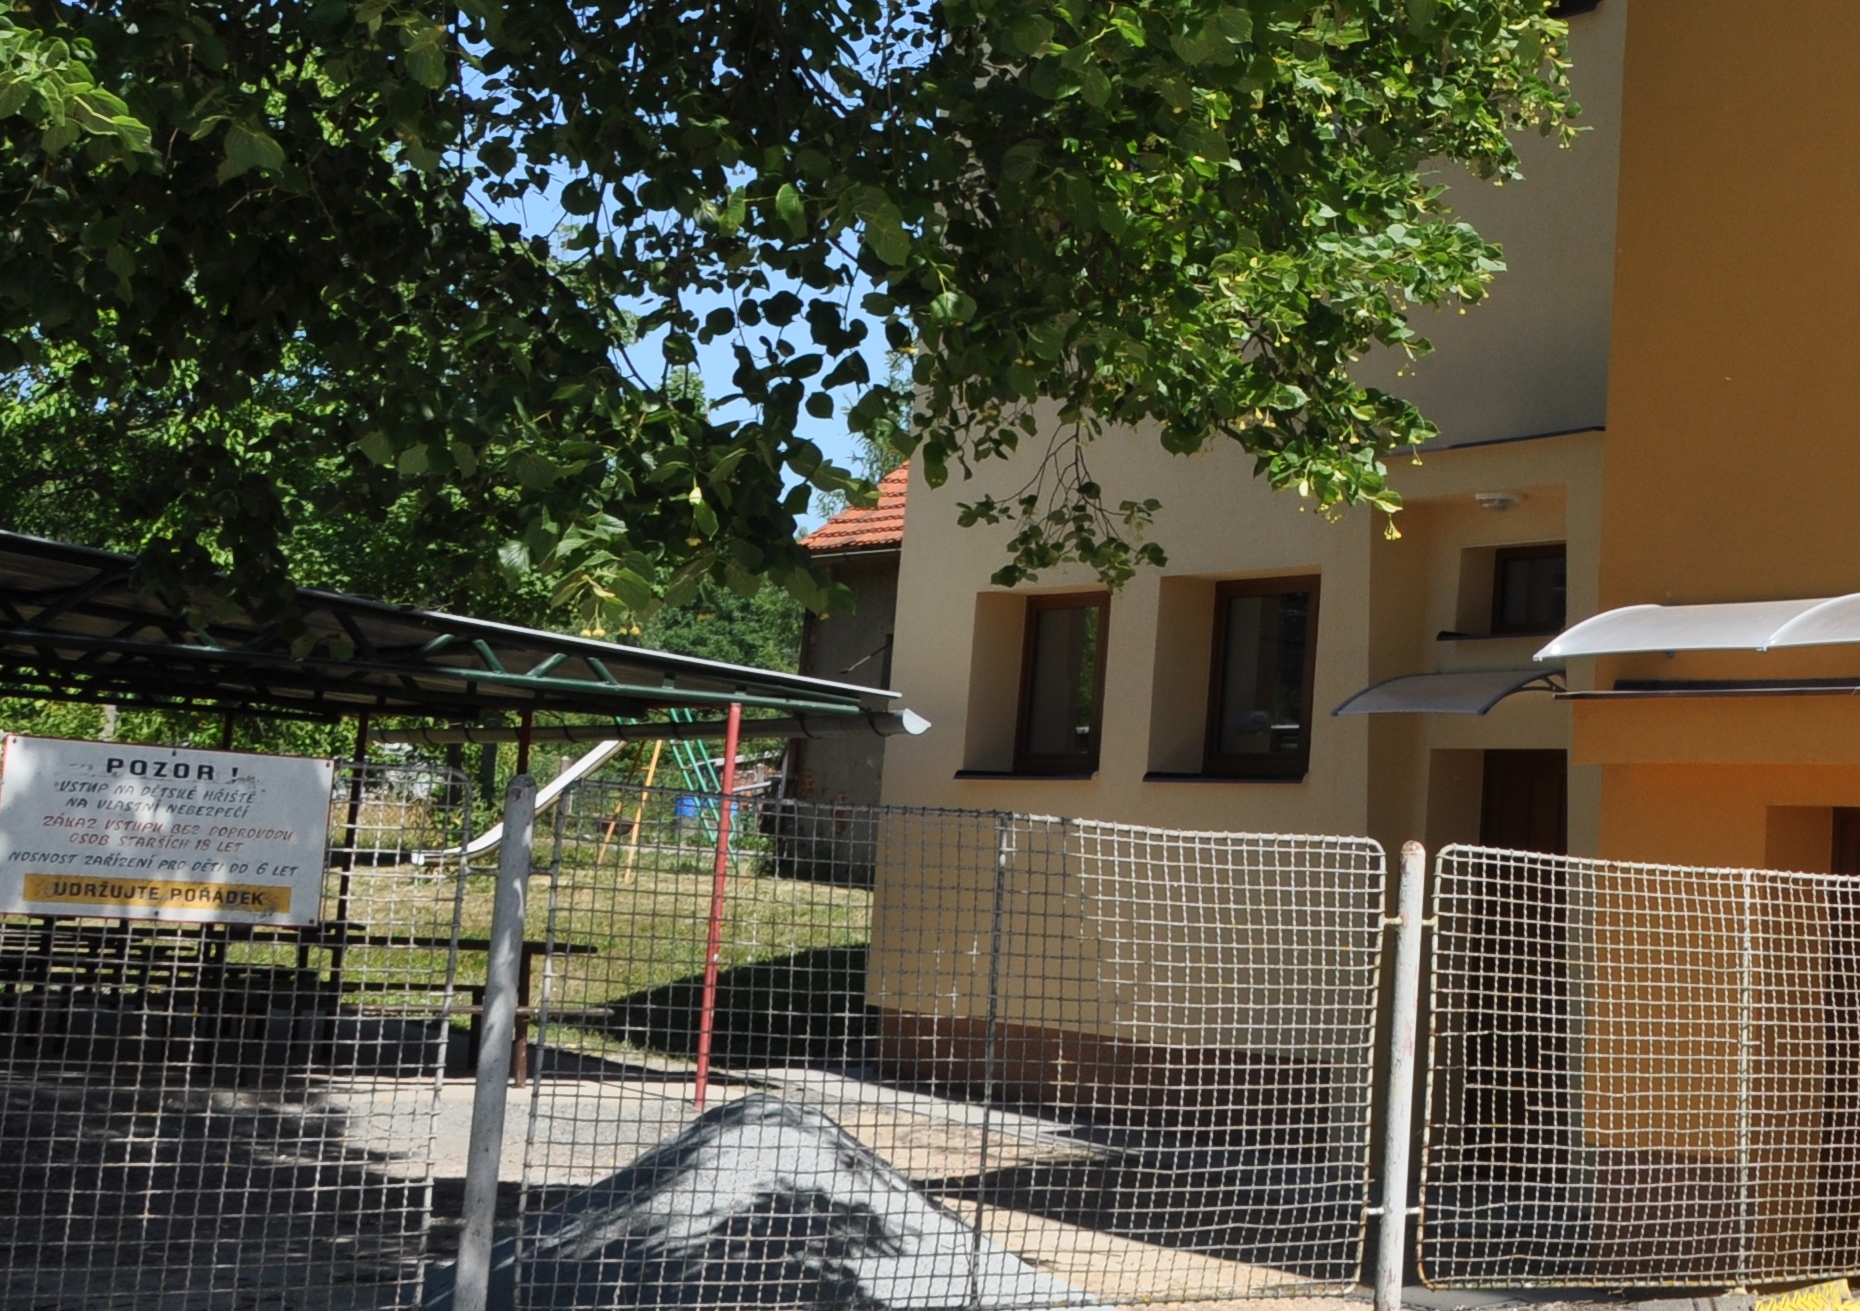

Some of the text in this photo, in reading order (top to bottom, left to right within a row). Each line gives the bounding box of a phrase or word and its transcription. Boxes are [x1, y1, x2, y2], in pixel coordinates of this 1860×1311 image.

[106, 758, 239, 784] POZOR !
[59, 780, 257, 804] VSTUP NA DĚTSKÉ HŘIŠTĚ
[65, 797, 250, 819] NA VLASTNÍ NEBEZPEČÍ
[43, 812, 295, 842] ZÁKAZ VSTUPU BEZ DOPROVODU
[69, 832, 245, 853] OSOB STARŠÍCH 18 LET
[7, 851, 299, 877] NOSNOST ZAŘÍZENÍ PRO DĚTI DO 6 LET
[53, 881, 266, 906] UDRŽUJTE POŘÁDEK
